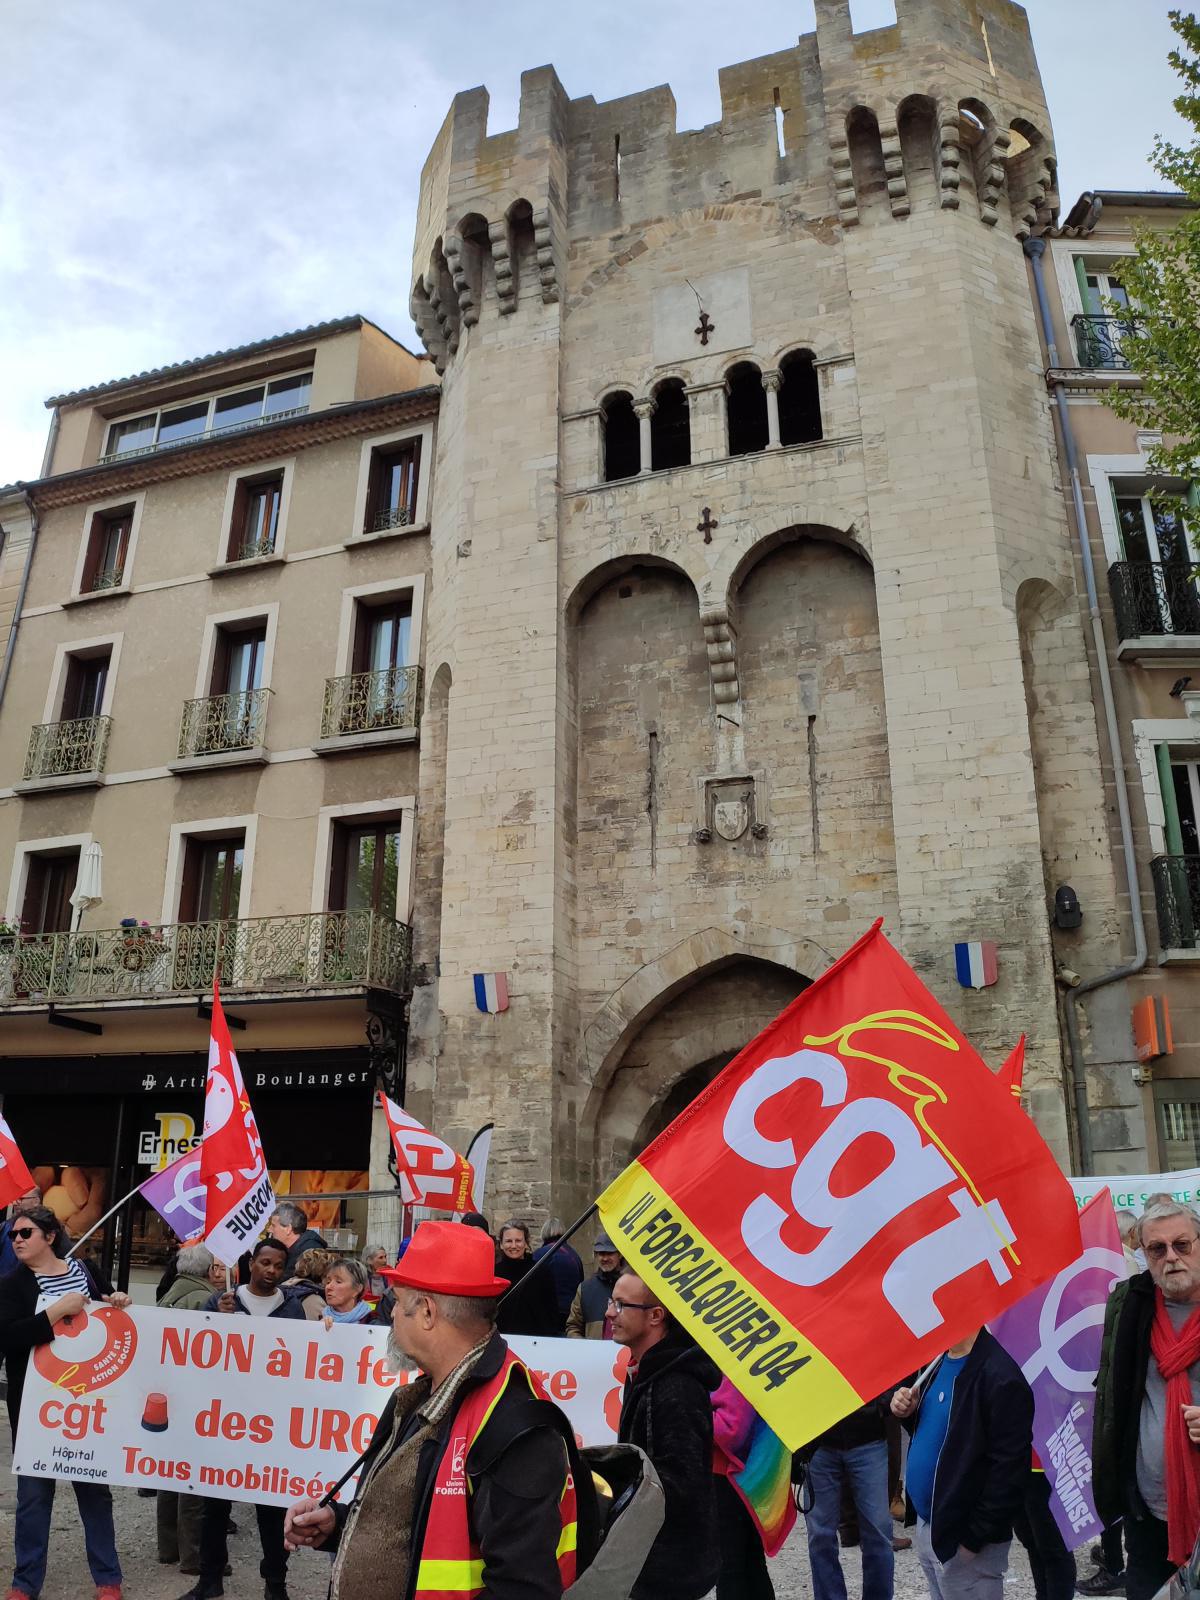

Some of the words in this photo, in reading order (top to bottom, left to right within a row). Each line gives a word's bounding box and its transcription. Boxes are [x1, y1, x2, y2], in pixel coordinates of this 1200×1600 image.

[164, 1075, 206, 1088] Arti
[256, 1071, 369, 1086] Boulanger
[141, 1134, 203, 1154] Ernes
[618, 1191, 657, 1236] UL
[723, 1049, 1018, 1339] cgt
[630, 1208, 781, 1362] FORCALQUIER
[91, 1364, 119, 1385] ACTION
[117, 1330, 132, 1365] SOCIALE
[160, 1327, 255, 1373] NON
[266, 1338, 292, 1378] à
[304, 1341, 345, 1383] la
[748, 1341, 813, 1392] 04
[39, 1399, 108, 1440] cgt
[194, 1399, 275, 1444] des
[1070, 1400, 1086, 1422] LA
[33, 1459, 47, 1471] de
[53, 1462, 108, 1478] Manosque
[52, 1446, 95, 1462] Hôpital
[122, 1446, 192, 1481] Tous
[199, 1463, 342, 1501] mobilisés
[1056, 1411, 1093, 1489] FRANCE
[1045, 1431, 1096, 1534] INSUMISE
